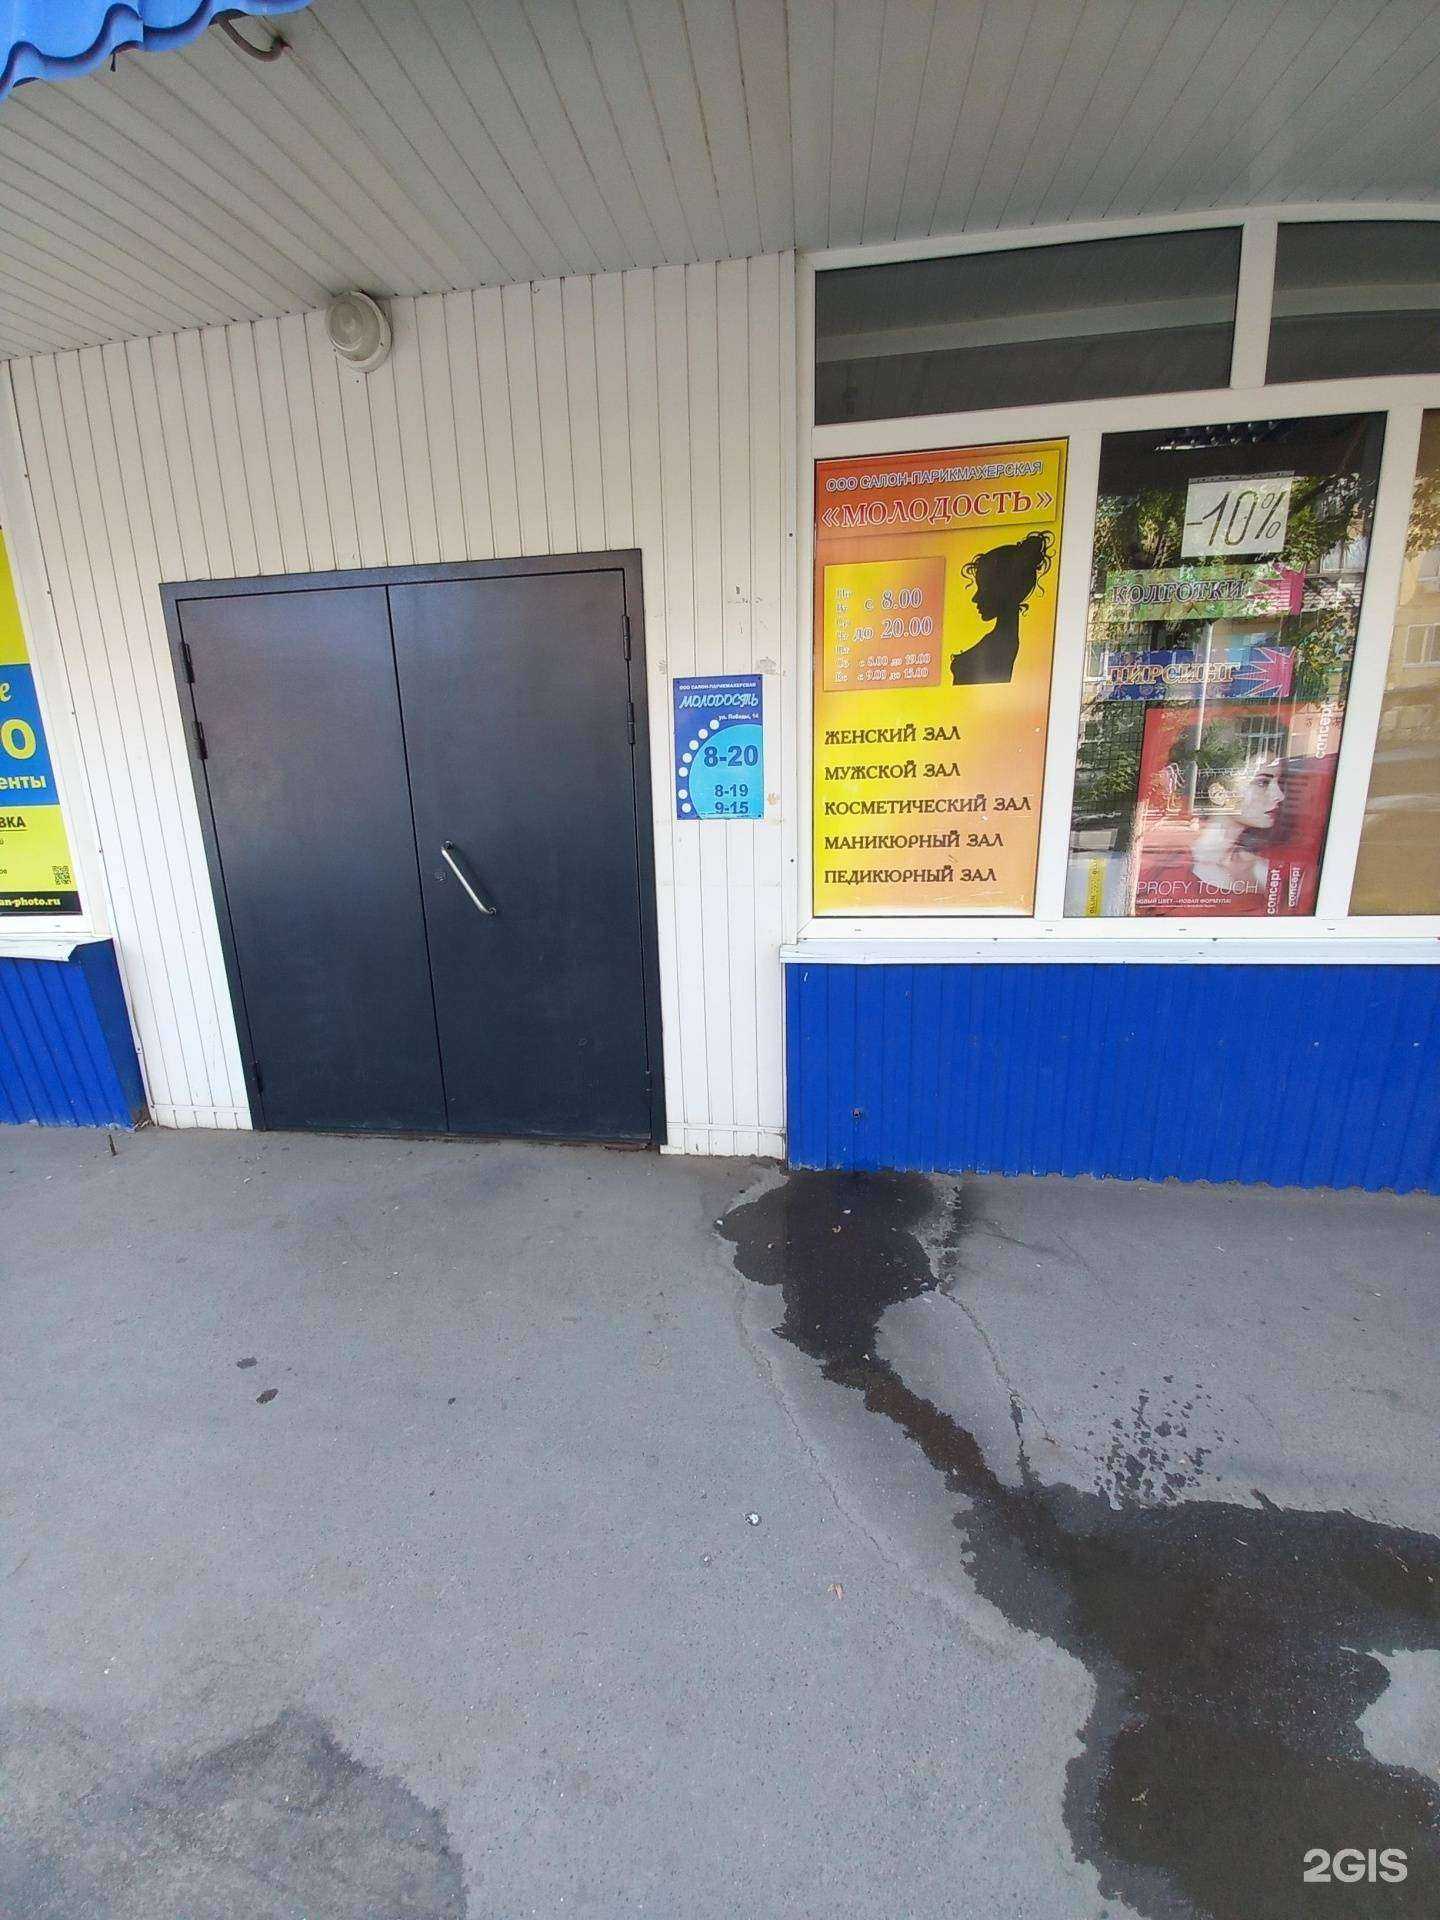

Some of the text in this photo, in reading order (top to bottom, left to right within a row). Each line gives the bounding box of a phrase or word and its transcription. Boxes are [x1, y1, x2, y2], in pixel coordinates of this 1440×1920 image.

[826, 461, 1043, 492] ООО САЛОН-ПАРИКМАХЕРСКАЯ
[822, 490, 1054, 528] «МОЛОДОСТЬ»
[1187, 490, 1286, 547] -10%
[881, 587, 923, 609] 8.00
[1112, 580, 1246, 604] КОЛГОТКИ
[853, 616, 933, 642] до 20.00
[1106, 662, 1240, 685] ПИРСИНГ
[824, 723, 961, 745] ЖЕНСКИЙ ЗАЛ
[704, 745, 758, 767] 8-20
[824, 760, 961, 780] МУЖСКОЙ ЗАЛ
[715, 783, 749, 797] 8-19
[715, 801, 749, 814] 9-15
[824, 794, 1031, 816] КОСМЕТИЧЕСКИЙ ЗАЛ
[824, 830, 1004, 850] МАНИКЮРНЫЙ ЗАЛ
[824, 865, 996, 885] ПЕДИКЮРНЫЙ ЗАЛ
[1136, 880, 1259, 896] PROFY TOUCH
[1267, 868, 1282, 915] concept
[1288, 866, 1301, 907] concept
